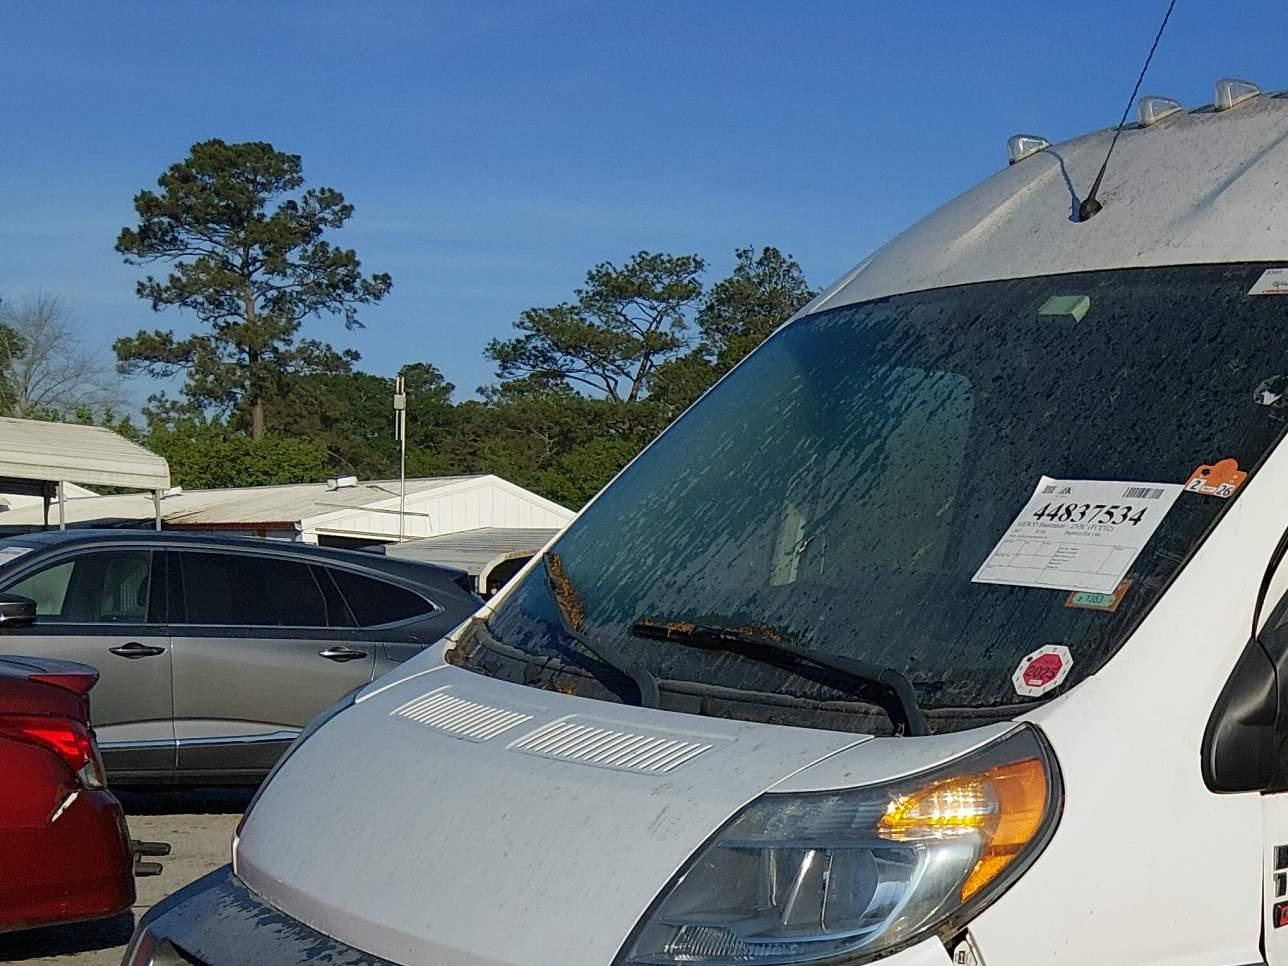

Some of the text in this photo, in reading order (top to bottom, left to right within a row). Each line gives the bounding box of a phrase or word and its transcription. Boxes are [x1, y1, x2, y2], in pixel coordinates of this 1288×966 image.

[1190, 480, 1202, 490] 2
[1216, 485, 1234, 497] 26
[1033, 502, 1148, 527] 44837534
[1027, 665, 1058, 680] 2025
